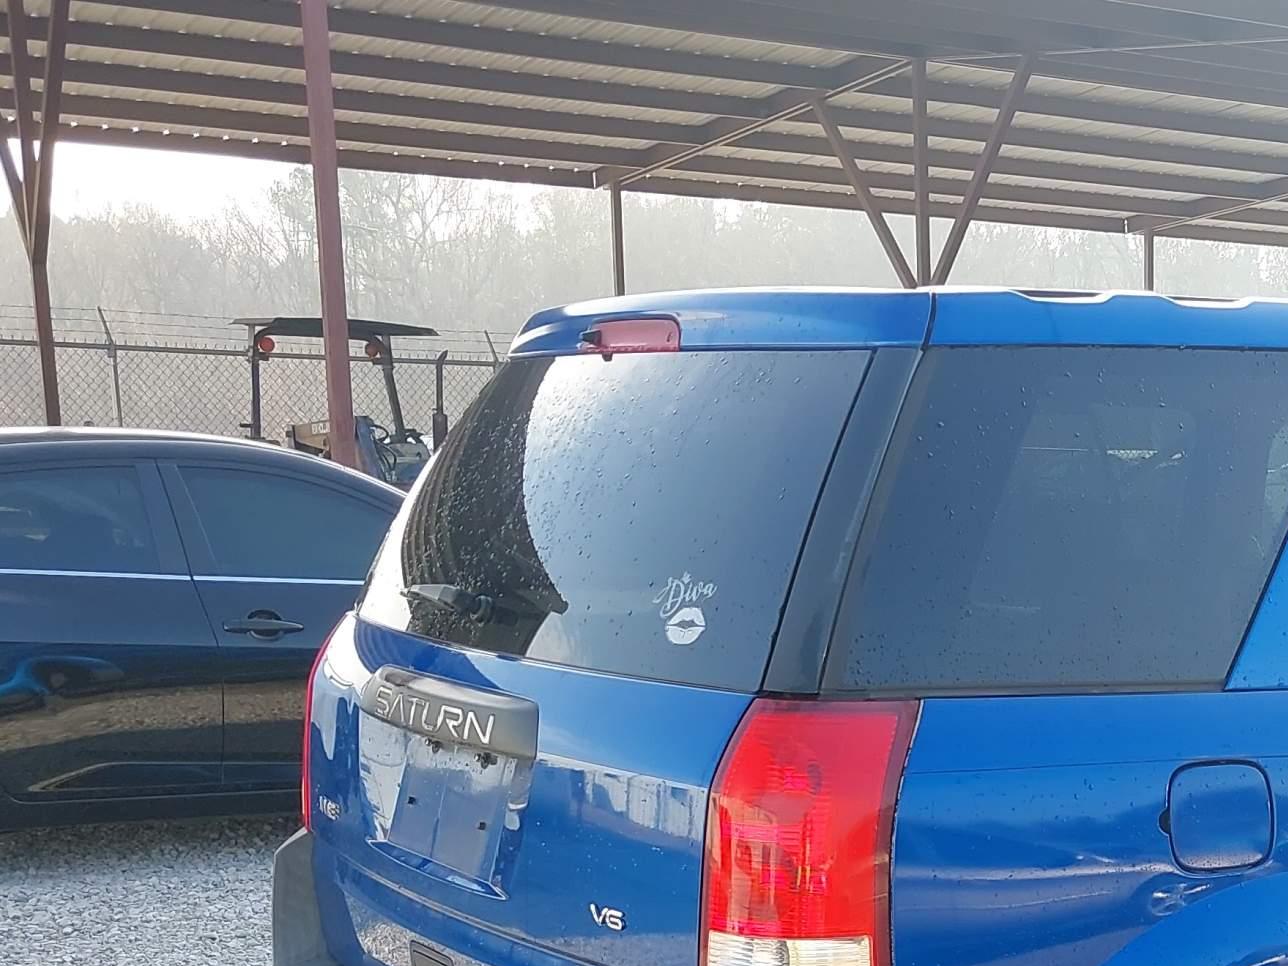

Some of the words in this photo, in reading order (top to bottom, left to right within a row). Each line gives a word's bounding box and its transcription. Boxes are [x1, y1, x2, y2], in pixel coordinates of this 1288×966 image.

[652, 577, 718, 618] Diva
[374, 685, 496, 744] SATURN
[590, 903, 624, 931] V6
